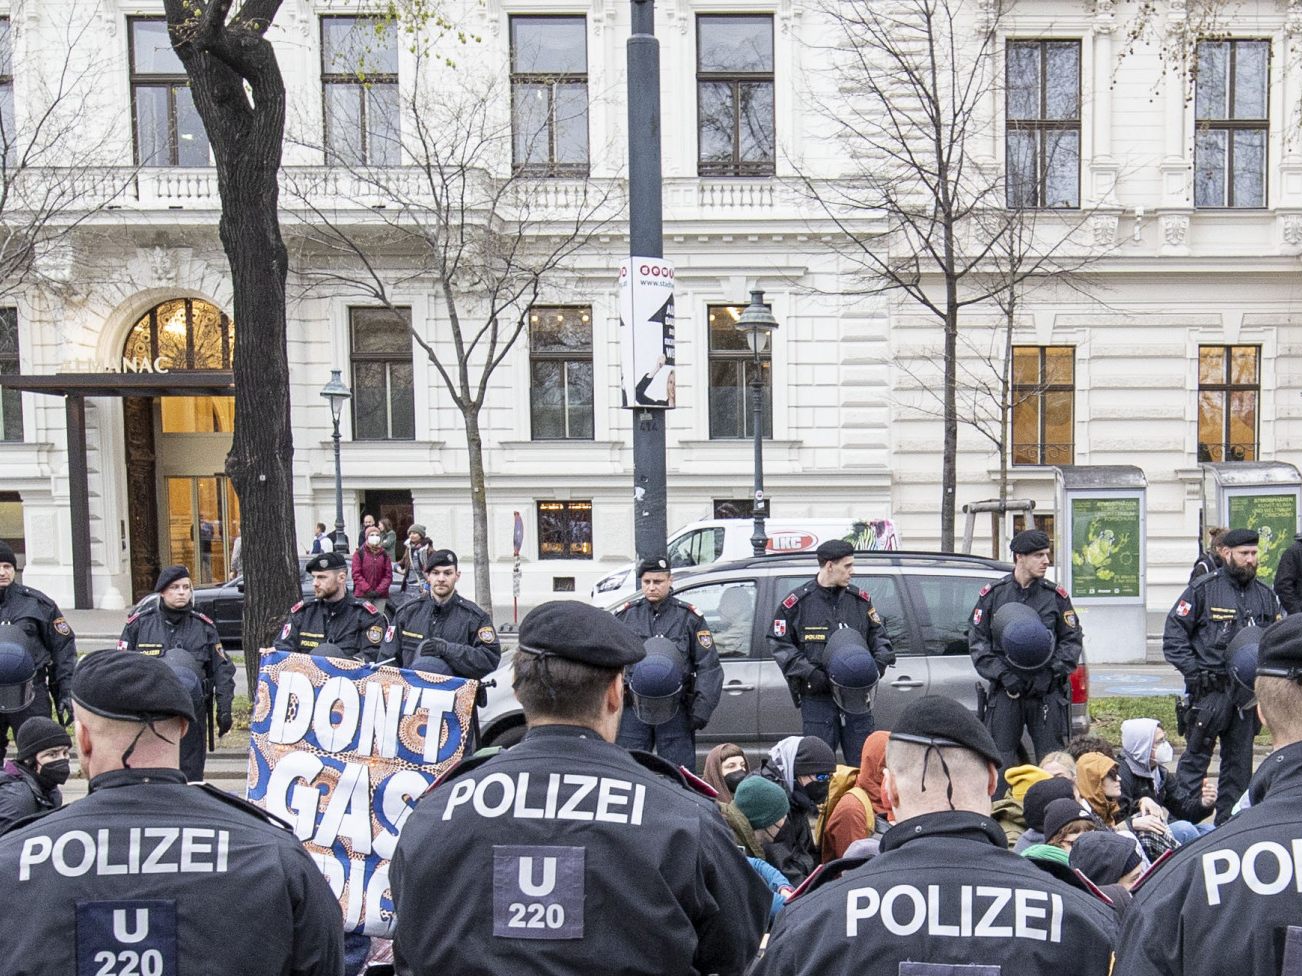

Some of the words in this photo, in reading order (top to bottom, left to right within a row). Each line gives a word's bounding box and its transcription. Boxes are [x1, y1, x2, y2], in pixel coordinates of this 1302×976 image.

[269, 671, 456, 764] DON'T
[266, 751, 429, 861] GAS
[442, 772, 646, 825] POLIZEI
[19, 827, 230, 881] POLIZEI
[518, 856, 557, 897] U
[113, 908, 149, 943] U
[507, 902, 565, 929] 220
[846, 884, 1063, 943] POLIZEI
